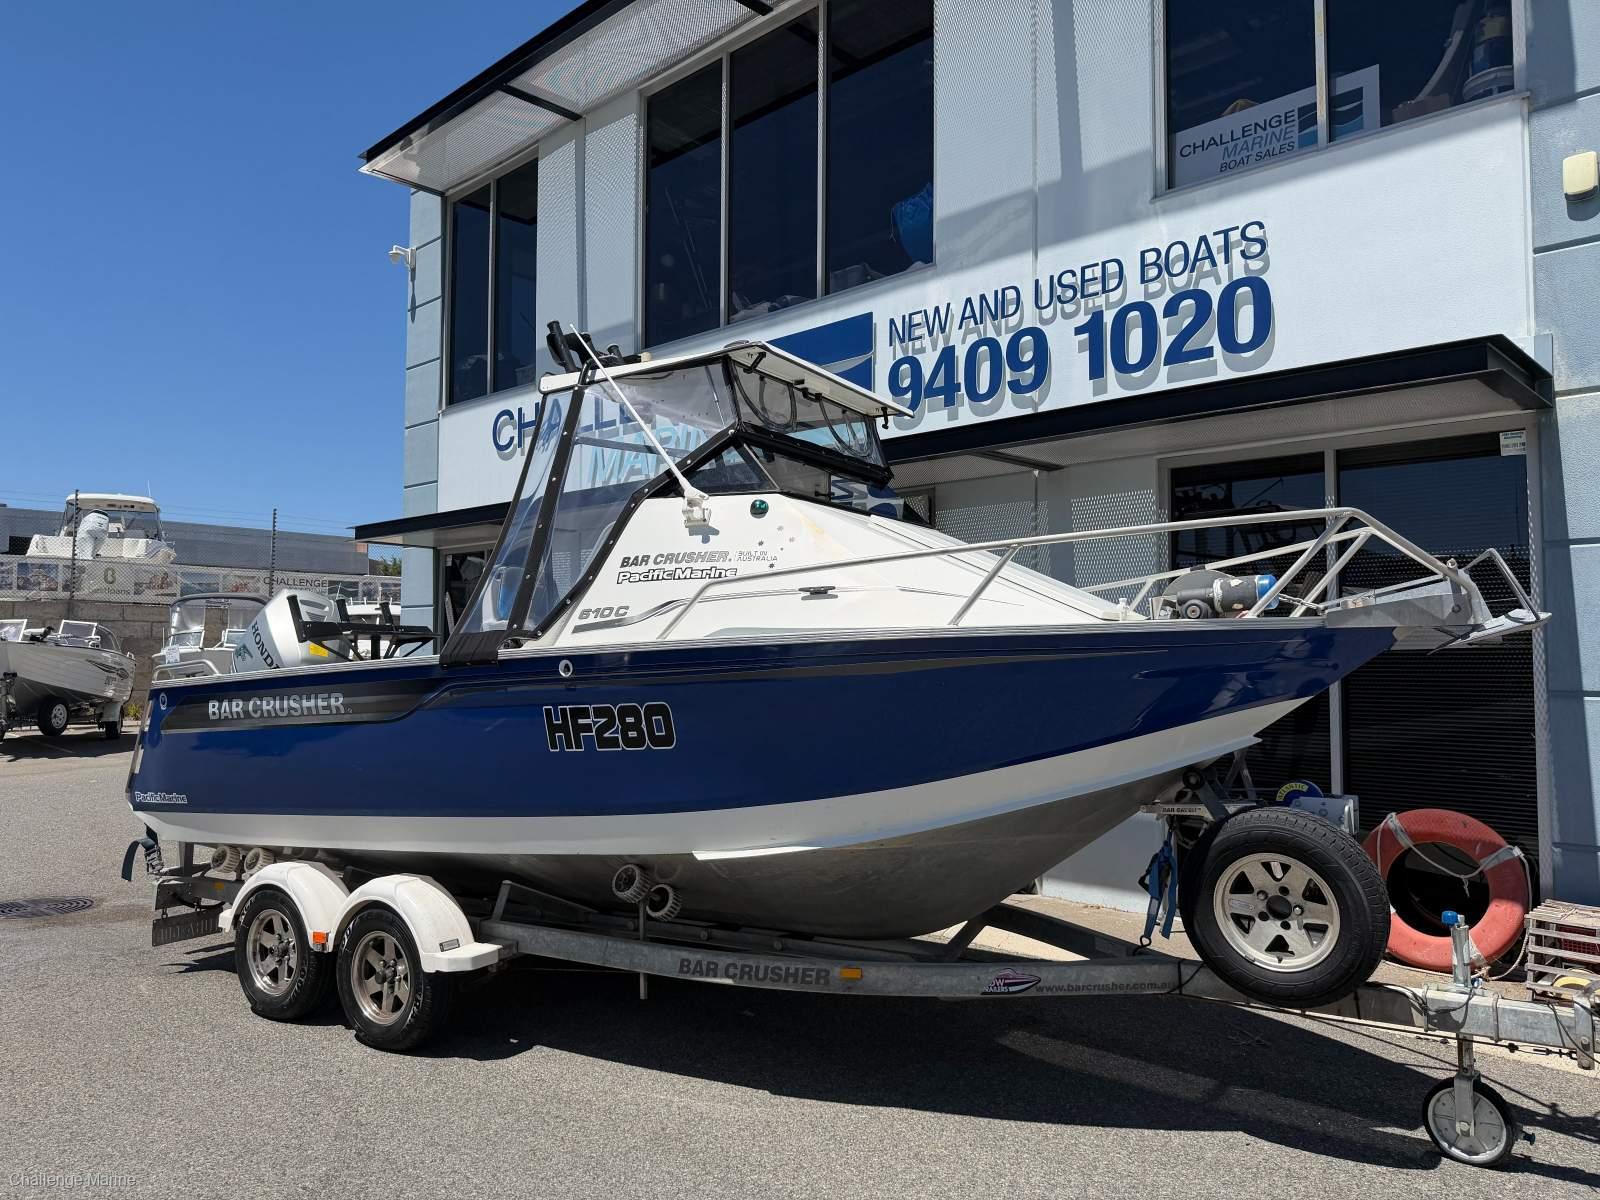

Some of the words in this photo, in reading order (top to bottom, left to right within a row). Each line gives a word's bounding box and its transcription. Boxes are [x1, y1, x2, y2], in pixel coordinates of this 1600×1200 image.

[1180, 109, 1296, 158] CHALLENGE
[1222, 124, 1296, 160] MARINE
[1219, 154, 1252, 172] BOAT
[1254, 141, 1296, 161] SALES
[888, 303, 951, 347] NEW
[958, 284, 1021, 331] AND
[1033, 257, 1124, 311] USED
[1140, 220, 1268, 285] BOATS
[888, 326, 1049, 412] 9409
[1074, 276, 1273, 381] 1020
[620, 554, 650, 568] BAR
[653, 551, 730, 565] CRUSHER
[263, 576, 328, 587] CHALLENGE
[578, 606, 630, 620] 610C
[208, 699, 245, 720] BAR
[248, 692, 346, 718] CRUSHER
[543, 702, 677, 752] HF280
[678, 958, 718, 977] BAR
[724, 962, 831, 986] CRUSHER
